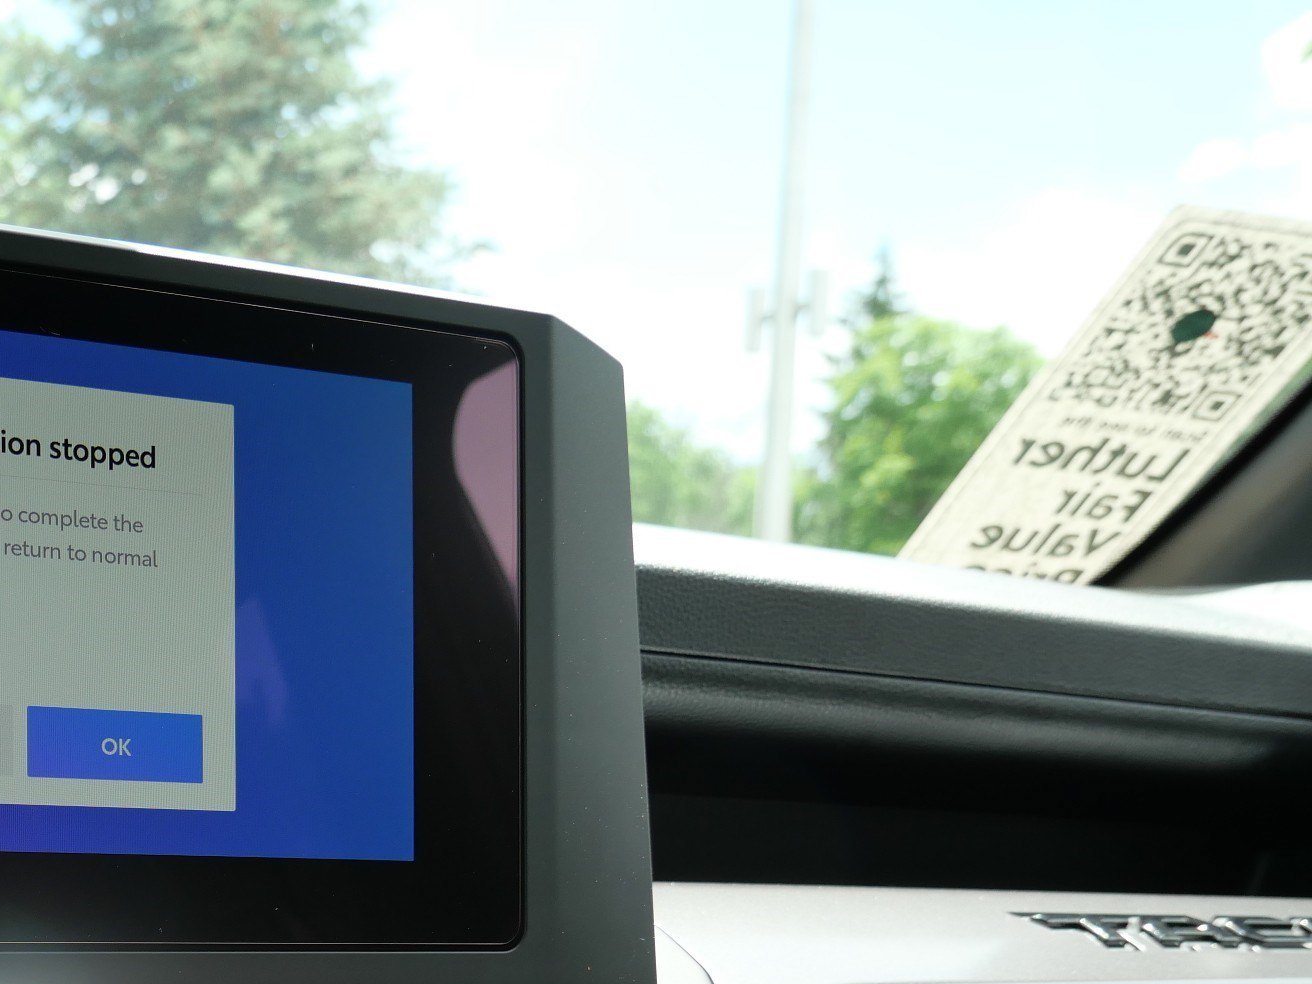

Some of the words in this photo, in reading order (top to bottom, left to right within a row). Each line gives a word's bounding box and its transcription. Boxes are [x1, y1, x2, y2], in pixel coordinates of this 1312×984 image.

[49, 438, 157, 470] stopped
[18, 509, 109, 531] complete
[113, 513, 144, 534] the
[4, 540, 62, 560] return
[67, 545, 87, 562] to
[92, 549, 159, 568] normal
[100, 736, 132, 758] OK
